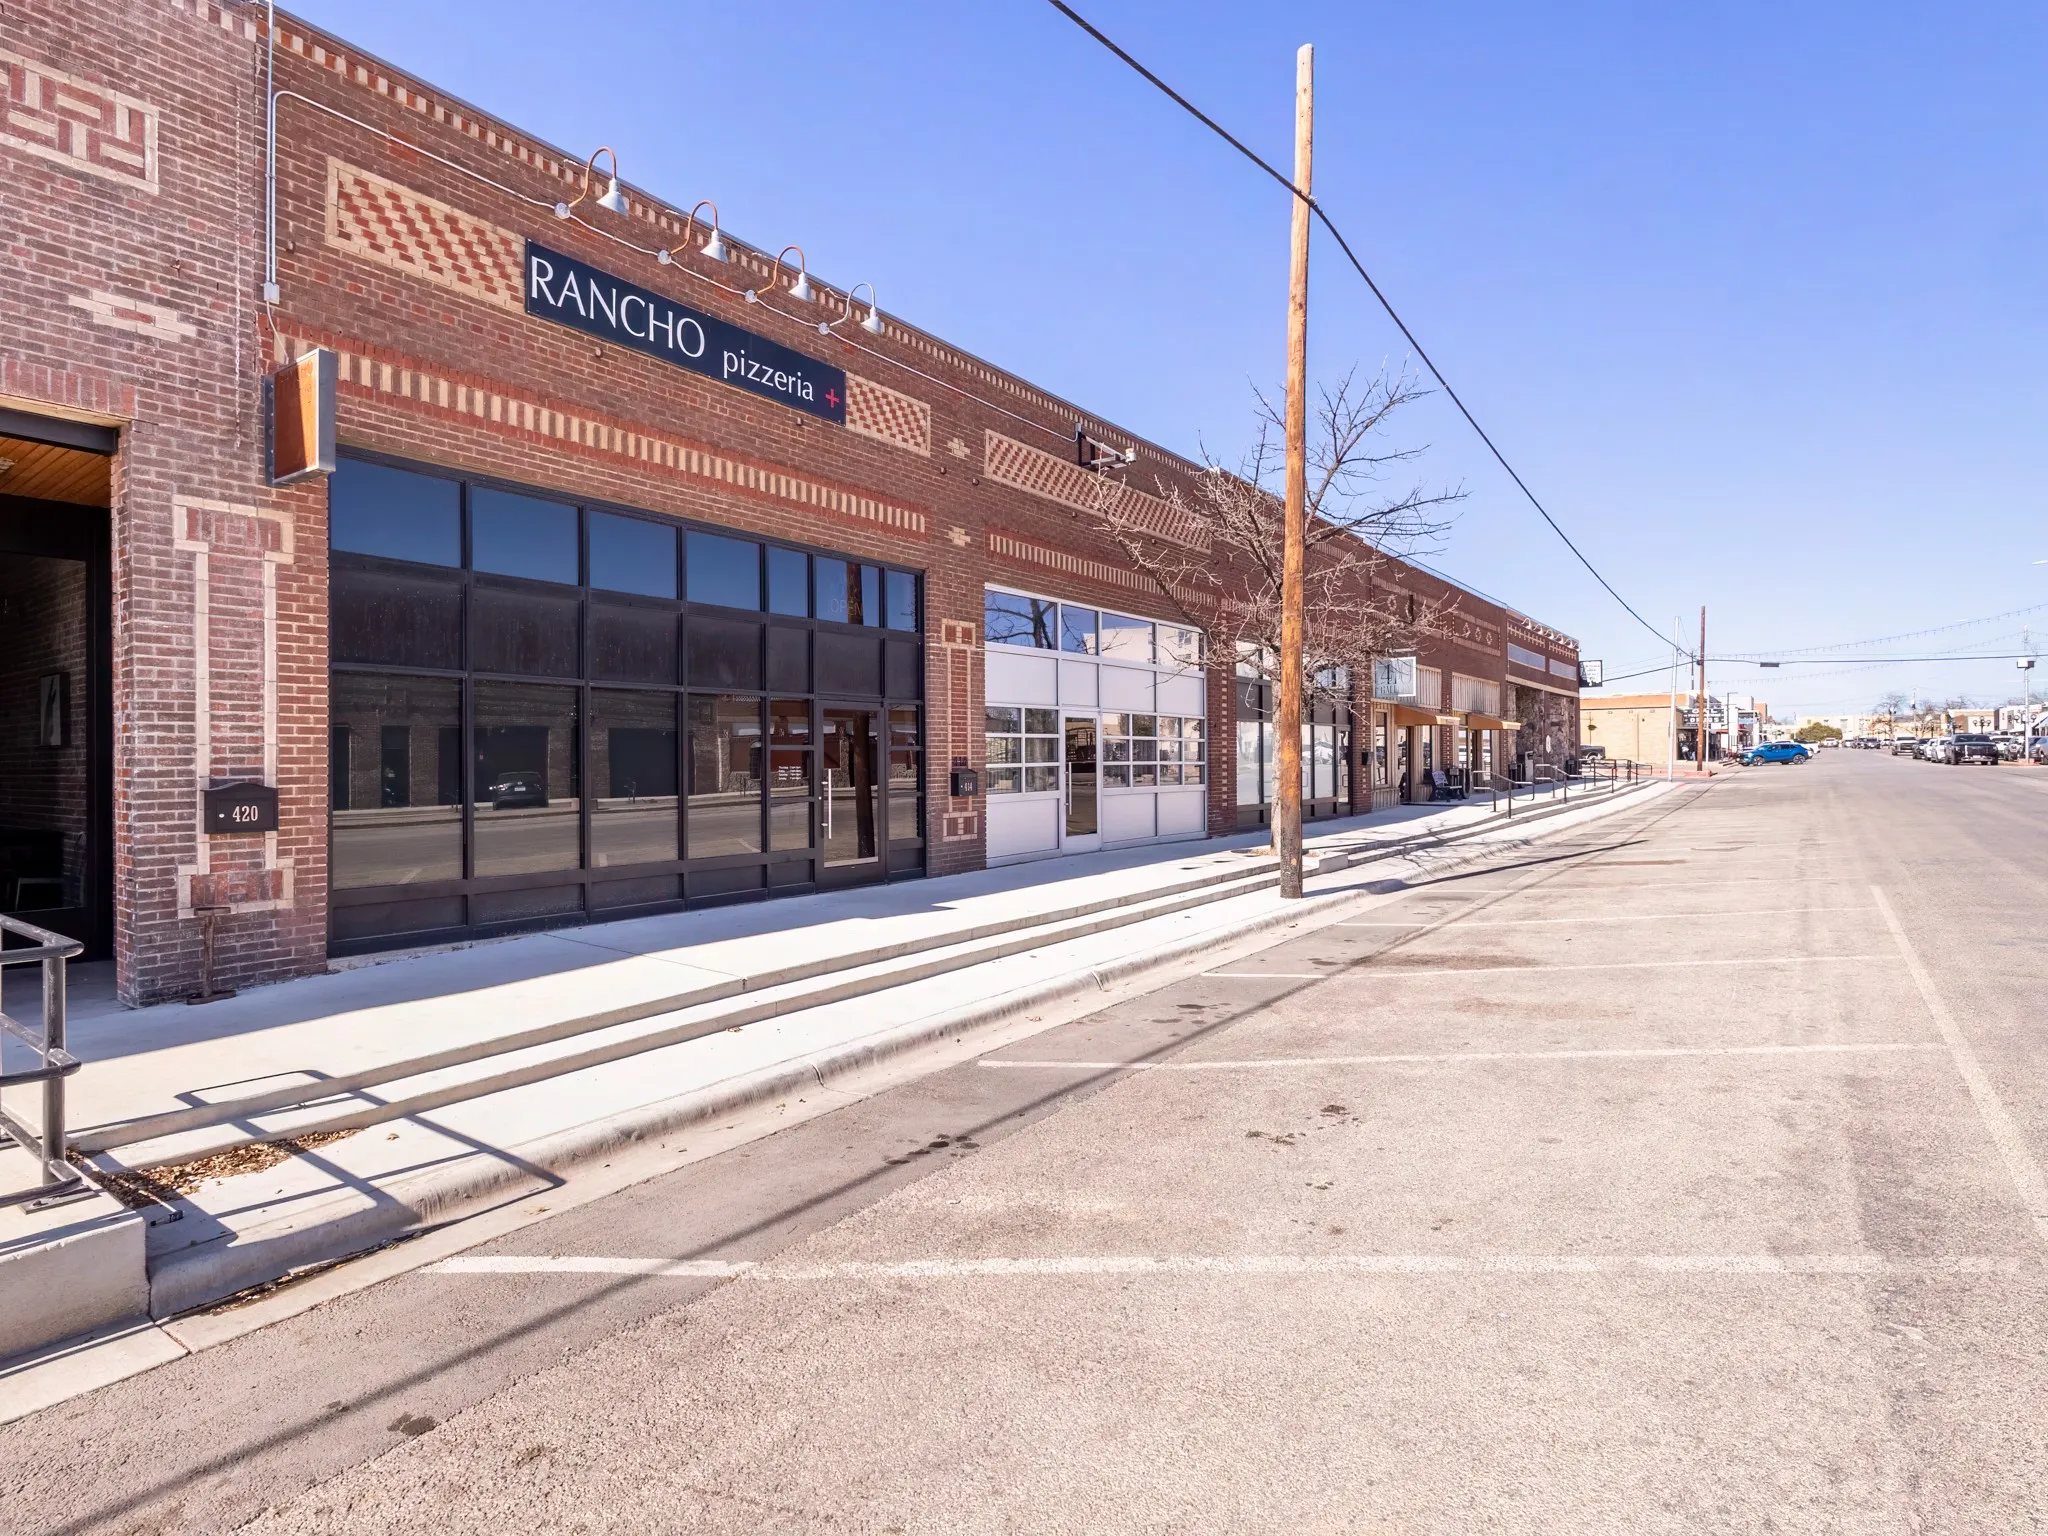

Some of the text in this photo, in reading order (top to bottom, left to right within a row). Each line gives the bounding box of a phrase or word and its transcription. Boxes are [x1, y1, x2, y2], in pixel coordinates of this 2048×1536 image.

[531, 255, 706, 358] RANCHO
[723, 350, 814, 402] pizzeria
[232, 805, 258, 822] 420
